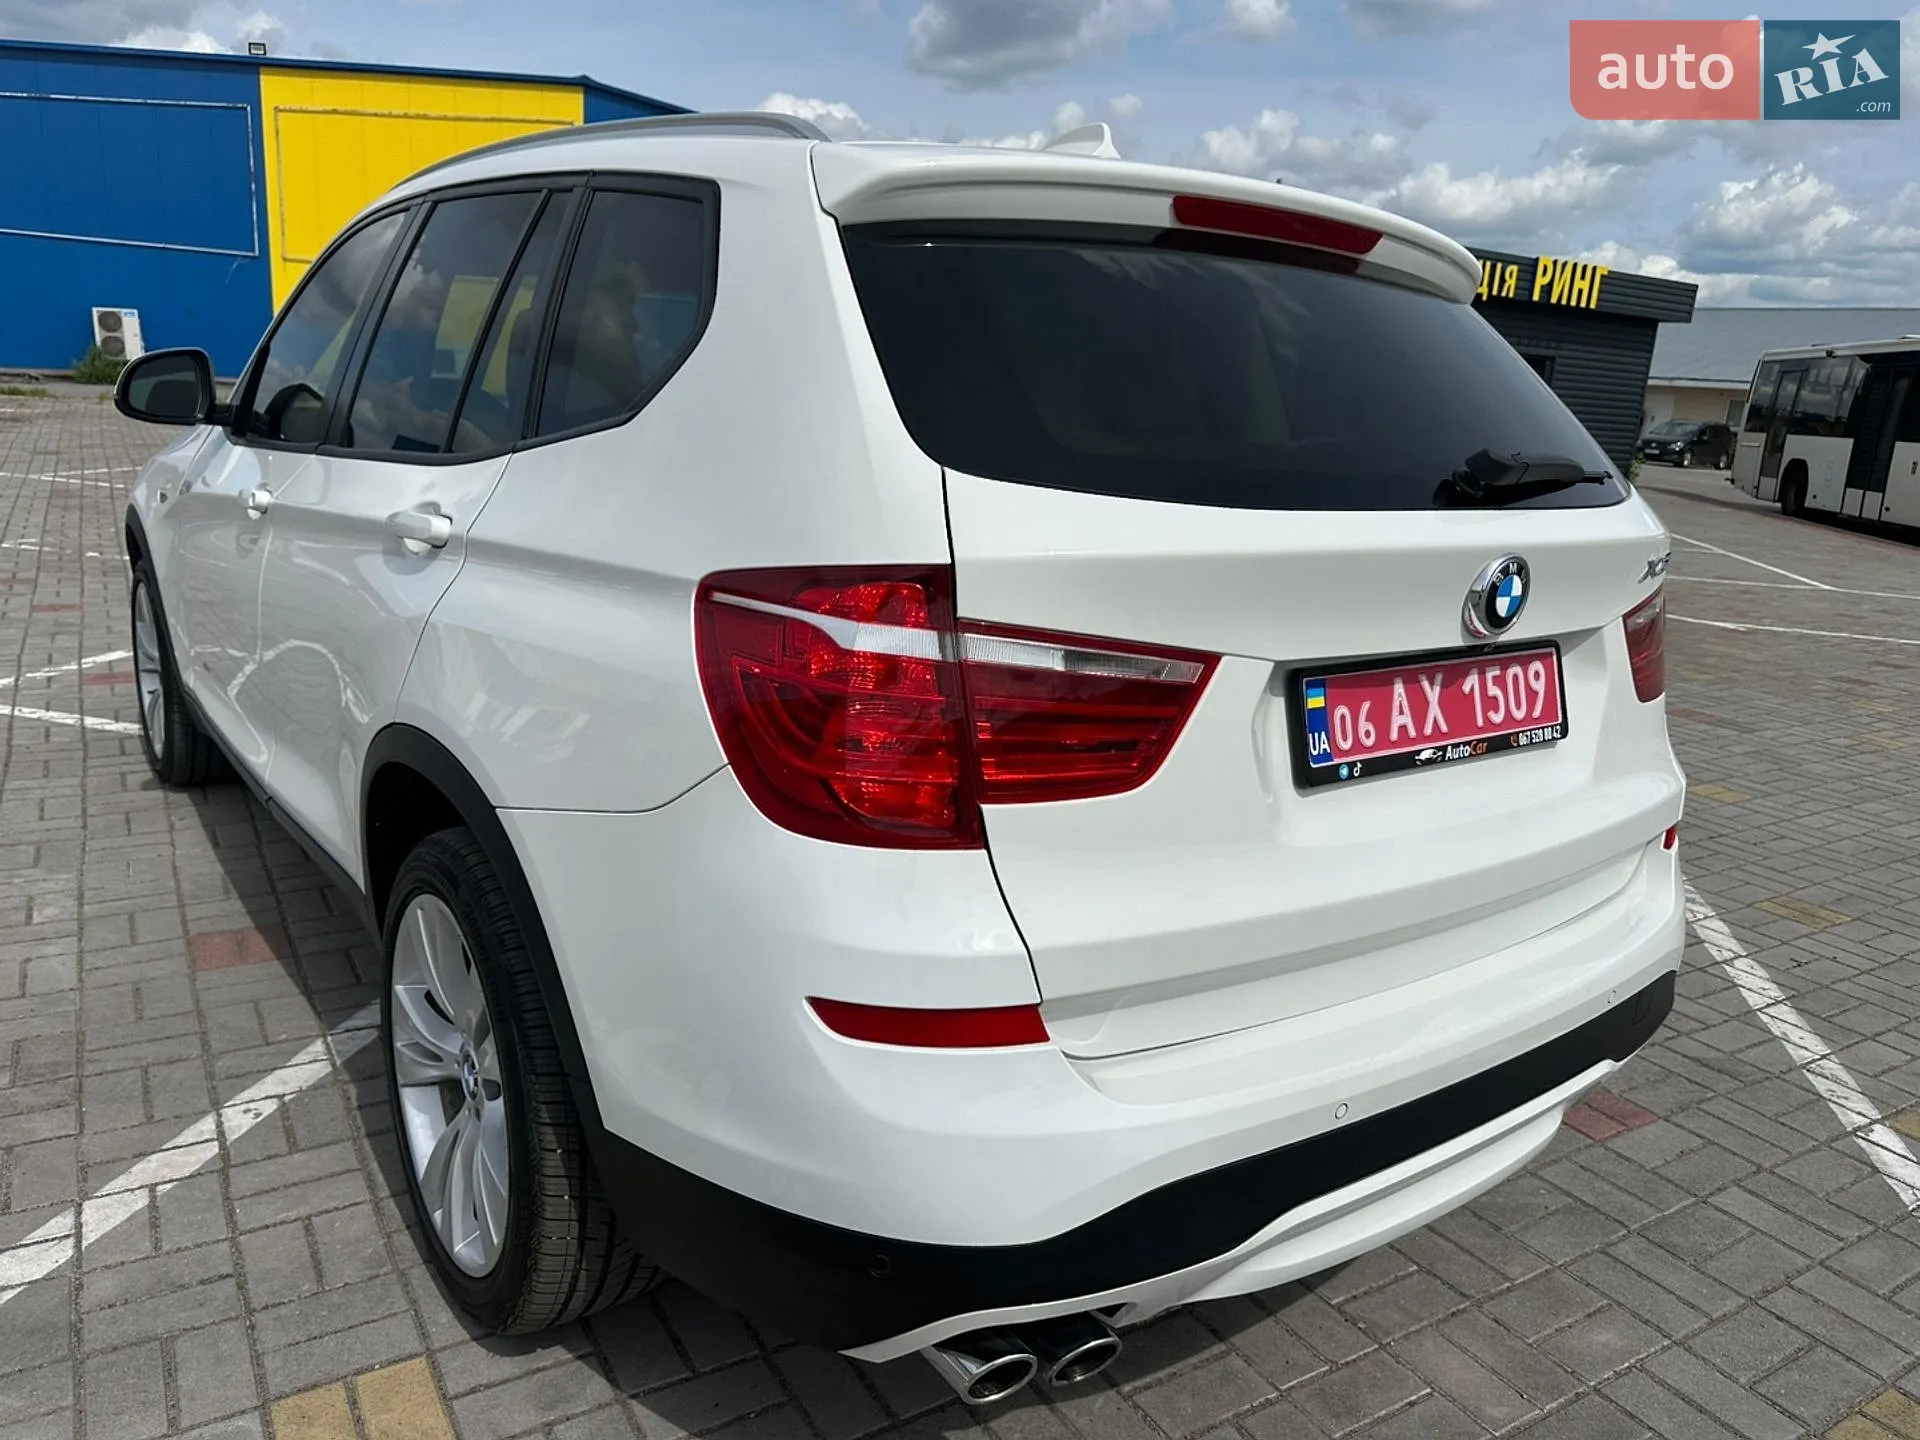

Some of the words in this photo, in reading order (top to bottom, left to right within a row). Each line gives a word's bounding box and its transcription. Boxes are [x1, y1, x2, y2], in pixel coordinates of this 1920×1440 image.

[1532, 255, 1608, 310] РИНГ
[1333, 701, 1376, 751] 06
[1389, 671, 1448, 742] AX
[1461, 660, 1546, 728] 1509
[1309, 731, 1330, 755] UA
